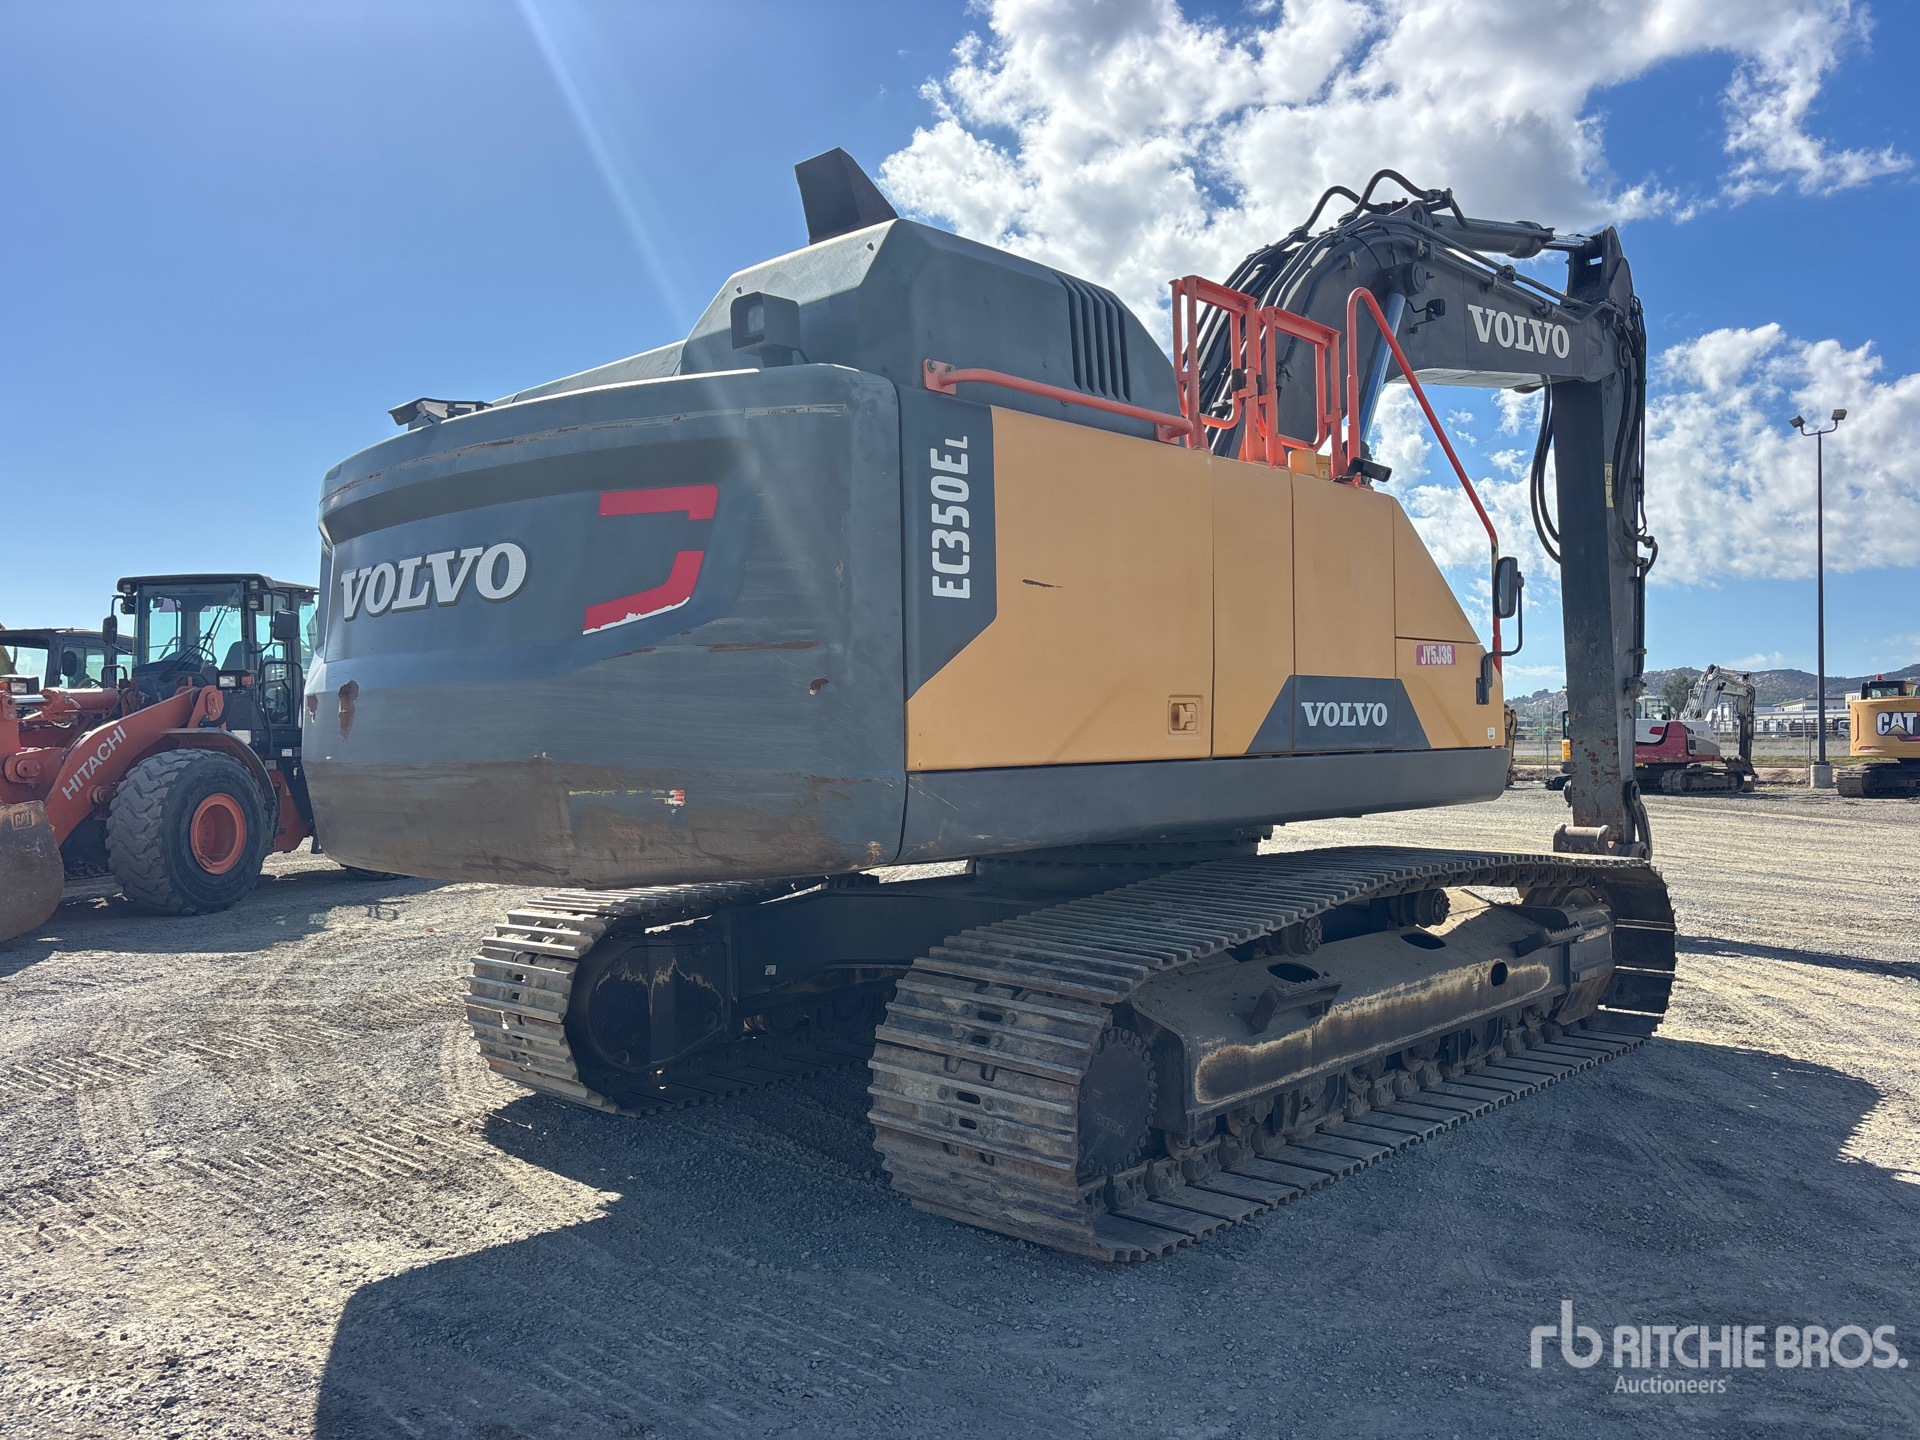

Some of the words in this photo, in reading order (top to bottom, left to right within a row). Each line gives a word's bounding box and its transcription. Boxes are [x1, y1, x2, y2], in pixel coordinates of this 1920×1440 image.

[1467, 303, 1570, 359] VOLVO
[340, 542, 527, 621] VOLVO
[1420, 645, 1453, 665] JY5J36
[1301, 702, 1388, 727] VOLVO
[1877, 712, 1917, 735] CAT
[61, 725, 127, 801] HITACHI
[14, 810, 33, 826] CAT
